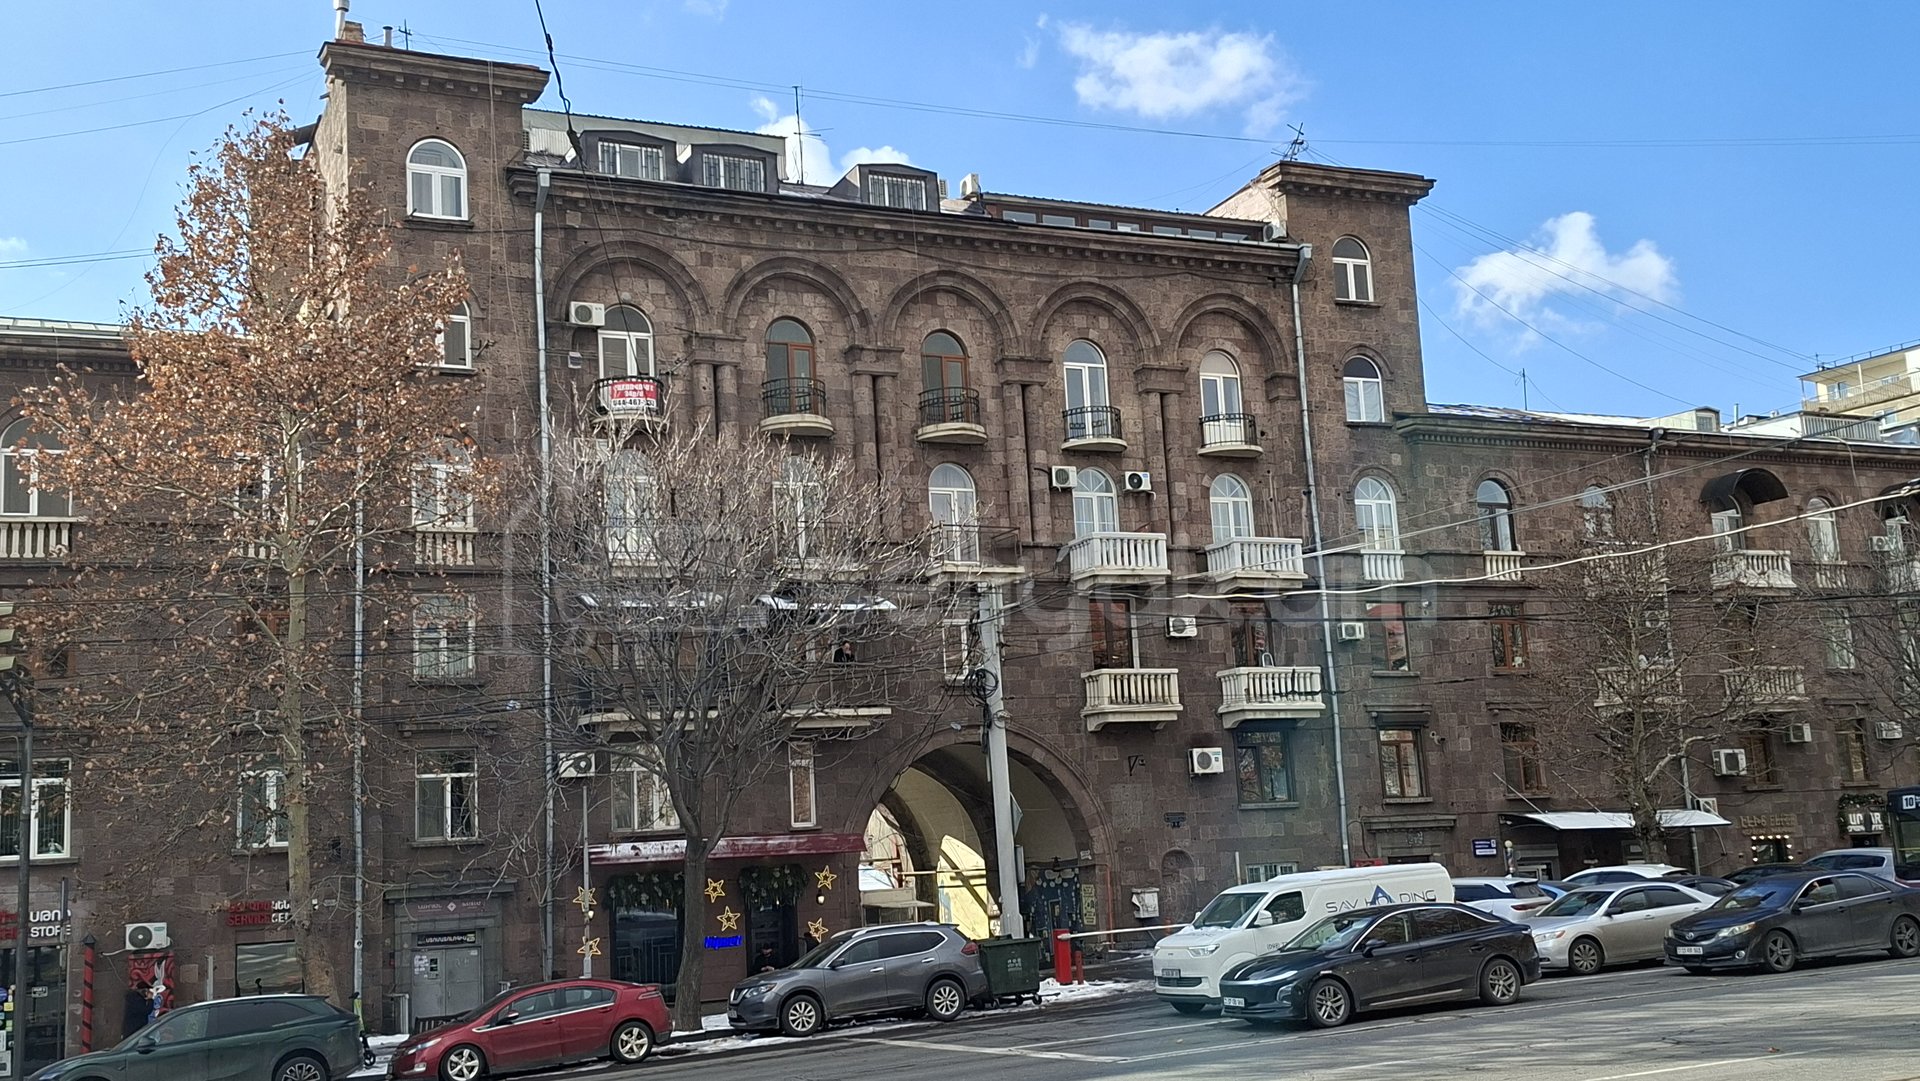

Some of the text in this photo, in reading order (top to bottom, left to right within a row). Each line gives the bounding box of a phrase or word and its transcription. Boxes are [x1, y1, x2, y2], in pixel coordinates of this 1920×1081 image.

[1904, 796, 1914, 808] 10
[1325, 899, 1359, 914] SAV
[227, 913, 271, 926] SERVICE
